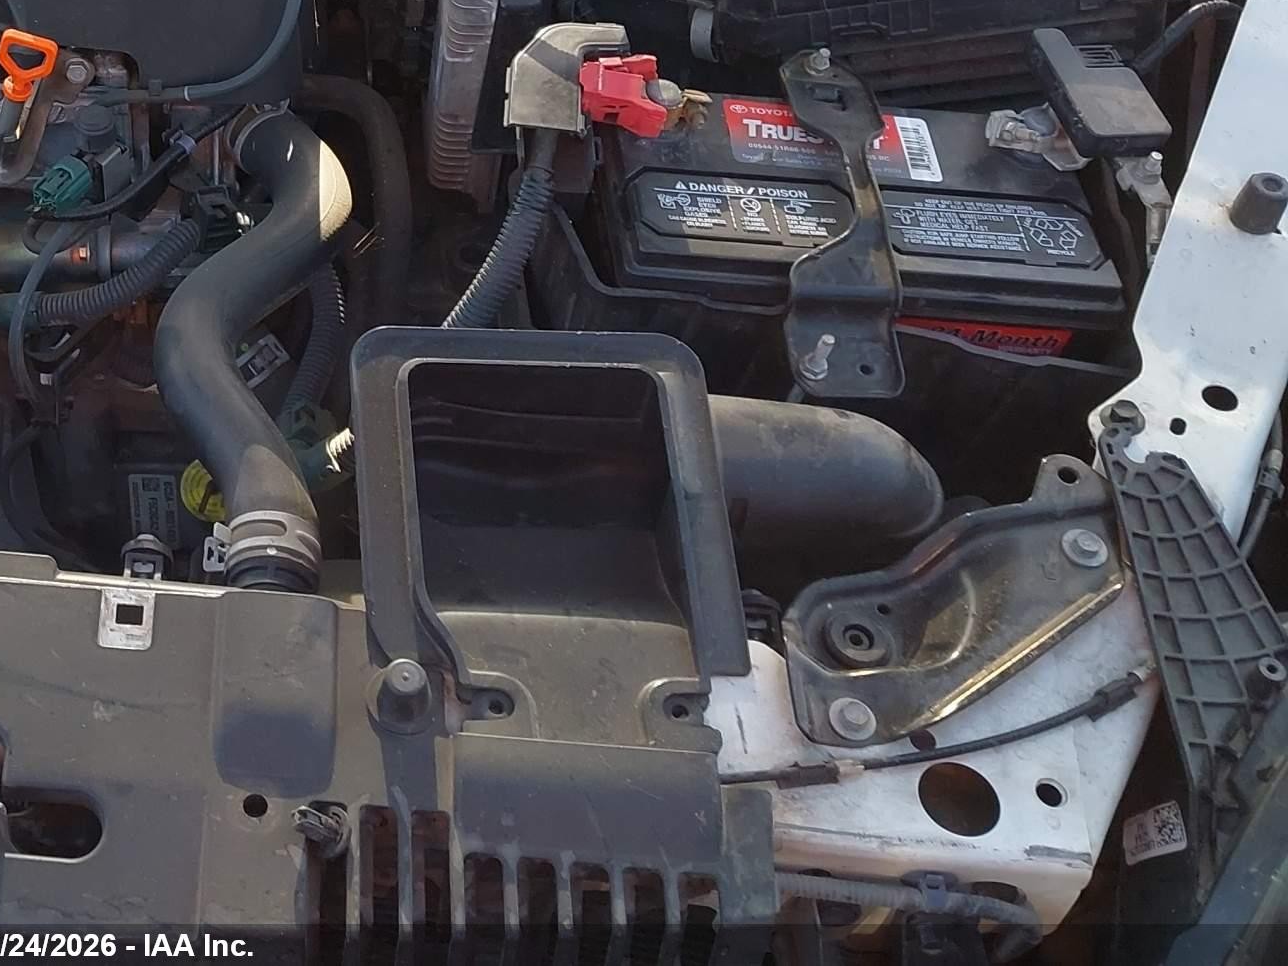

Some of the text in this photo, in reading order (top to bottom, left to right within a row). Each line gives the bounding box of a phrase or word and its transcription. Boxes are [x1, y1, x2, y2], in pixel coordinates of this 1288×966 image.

[749, 107, 793, 117] TOYOT
[689, 182, 744, 195] DANGER
[758, 188, 809, 199] POISON
[969, 328, 1059, 347] Month
